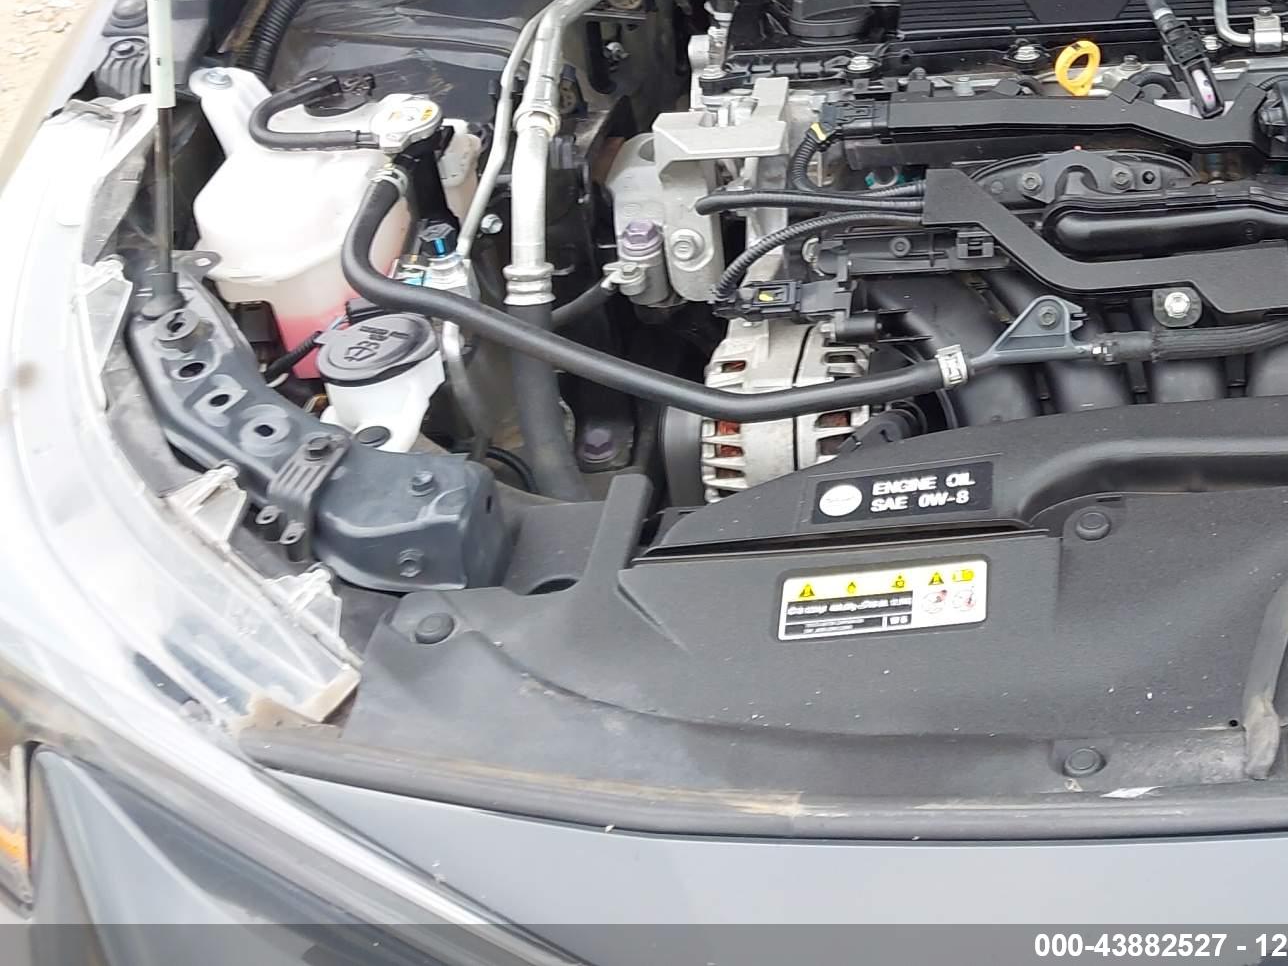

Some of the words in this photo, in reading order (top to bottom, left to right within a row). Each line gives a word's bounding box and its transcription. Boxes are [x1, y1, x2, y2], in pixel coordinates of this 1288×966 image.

[872, 475, 938, 496] ENGINE
[945, 472, 976, 488] OIL
[870, 496, 909, 513] SAE
[918, 490, 970, 508] 0W-8
